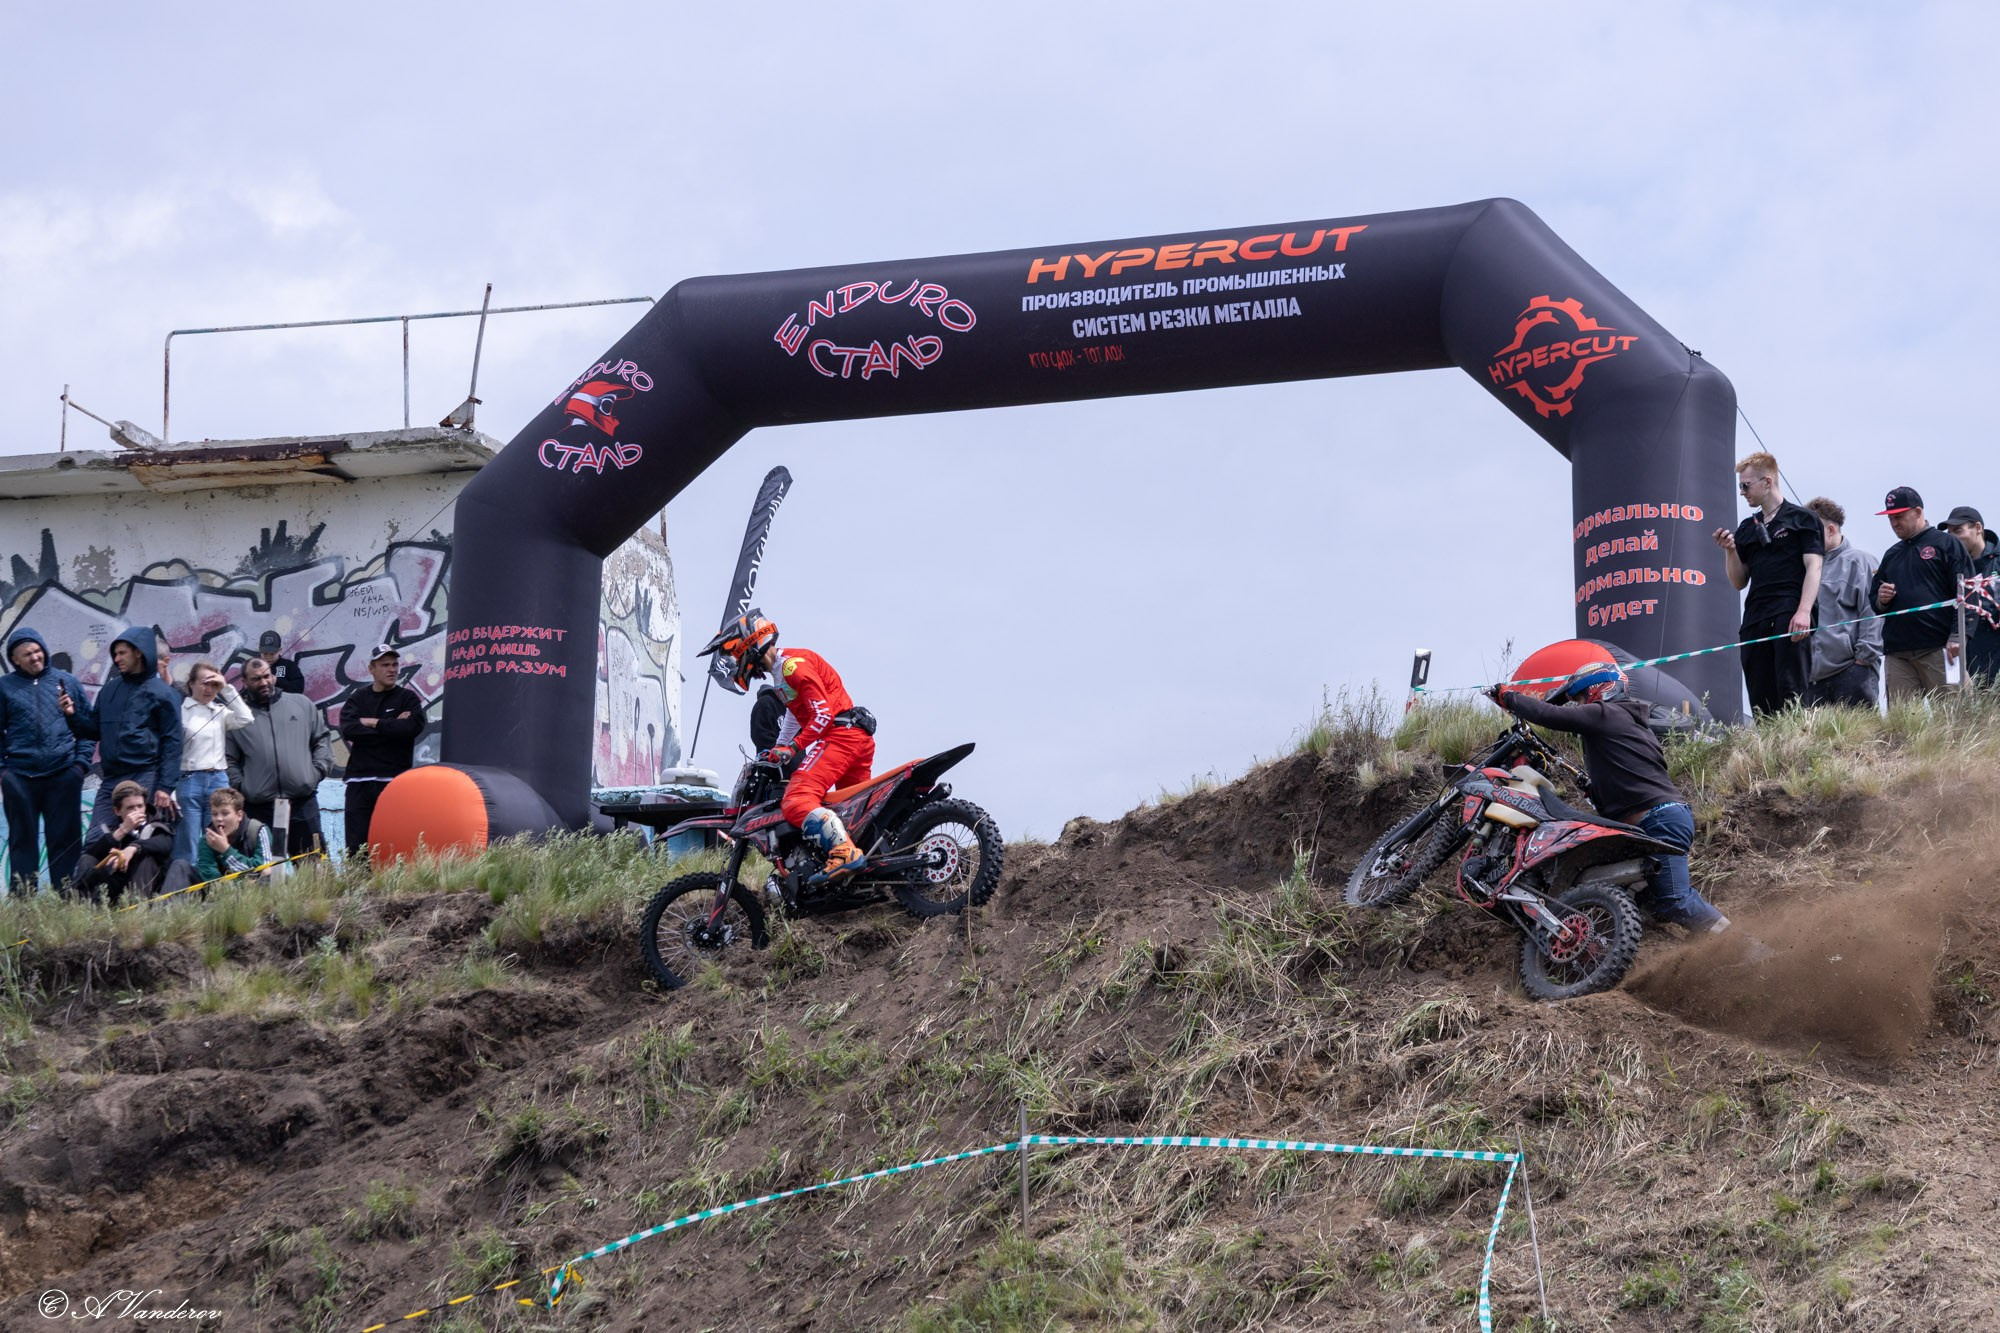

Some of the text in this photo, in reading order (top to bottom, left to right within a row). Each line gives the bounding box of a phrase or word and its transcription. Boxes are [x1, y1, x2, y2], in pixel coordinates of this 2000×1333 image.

[1027, 225, 1369, 284] HYPERCUT
[1021, 262, 1346, 312] ПРОИЗВОДИТЕЛЬ ПРОМЫШЛЕННЫХ
[774, 279, 977, 356] ENDURO
[1072, 296, 1302, 339] СИСТЕМ РЕЗКИ МЕТАЛЛА
[808, 335, 943, 380] СТАЛЬ
[1028, 352, 1049, 369] КТО
[1082, 346, 1102, 364] ТОТ
[1104, 344, 1126, 362] ЛОХ
[1488, 335, 1640, 385] HYPERCUT
[538, 439, 643, 474] СТАЛЬ
[1573, 503, 1704, 544] ормально
[1585, 529, 1658, 567] делай
[1575, 567, 1706, 608] ормально
[1588, 599, 1658, 627] будет
[452, 643, 541, 661] НАДО ЛИШЬ
[472, 625, 568, 642] ВЫДЕРЖИТ
[495, 661, 567, 678] РАЗУМ
[1499, 789, 1541, 814] Red Bull
